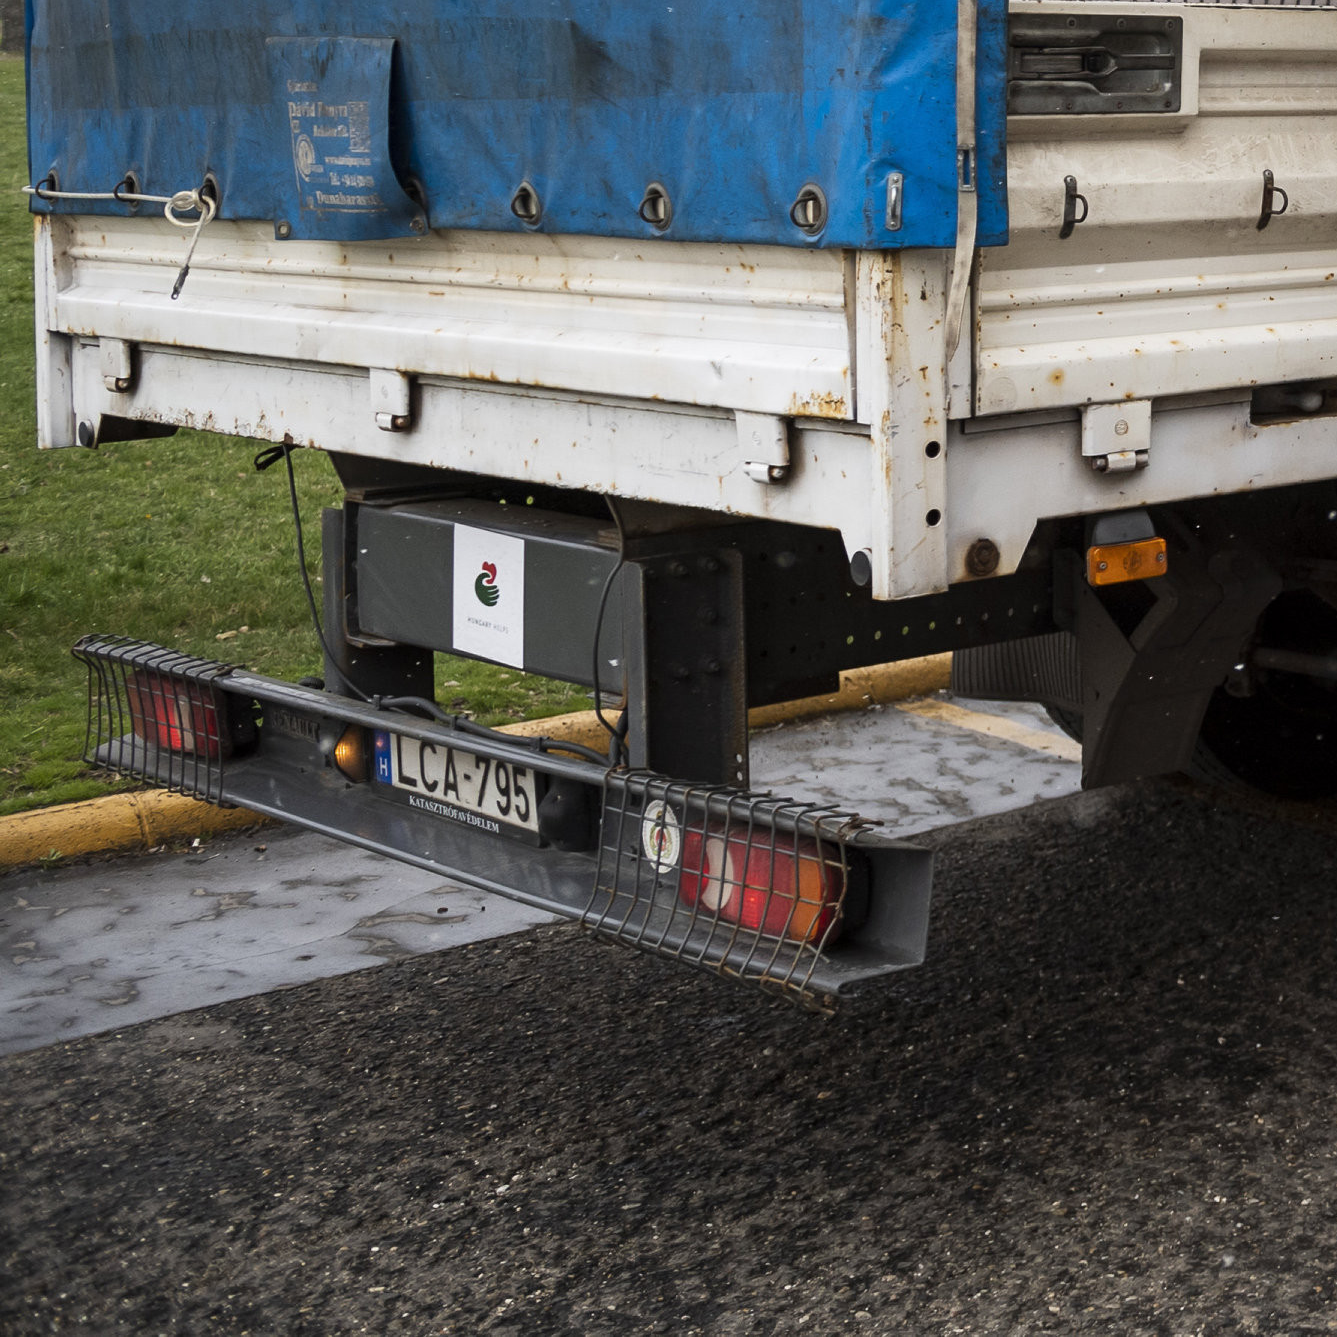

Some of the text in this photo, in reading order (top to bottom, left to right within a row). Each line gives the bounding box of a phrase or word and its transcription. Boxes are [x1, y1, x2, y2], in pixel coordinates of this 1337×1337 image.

[379, 757, 388, 777] H
[396, 734, 530, 823] LCA-795
[409, 795, 500, 834] KATASZTRÓFAVÉDELEM
